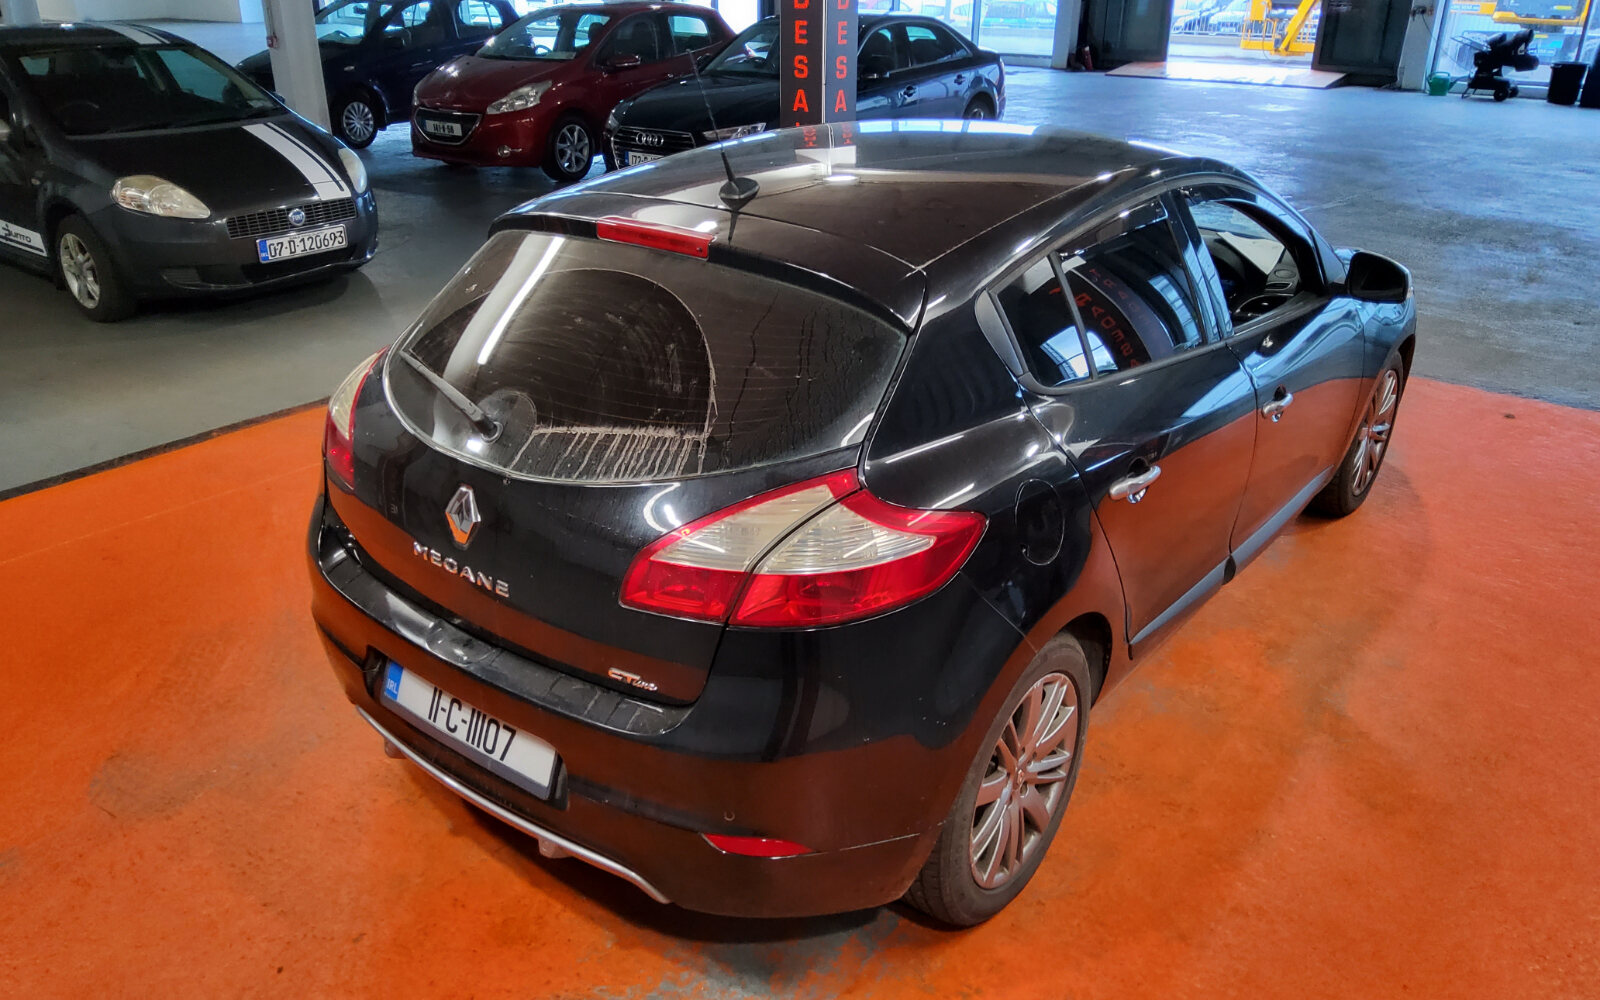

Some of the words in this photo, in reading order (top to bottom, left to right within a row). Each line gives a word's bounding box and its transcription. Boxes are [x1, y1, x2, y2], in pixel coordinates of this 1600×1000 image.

[268, 230, 345, 257] 07-D-120693
[413, 541, 510, 598] MEGANE
[386, 678, 398, 694] IRL
[427, 686, 516, 762] 11-C-11107
